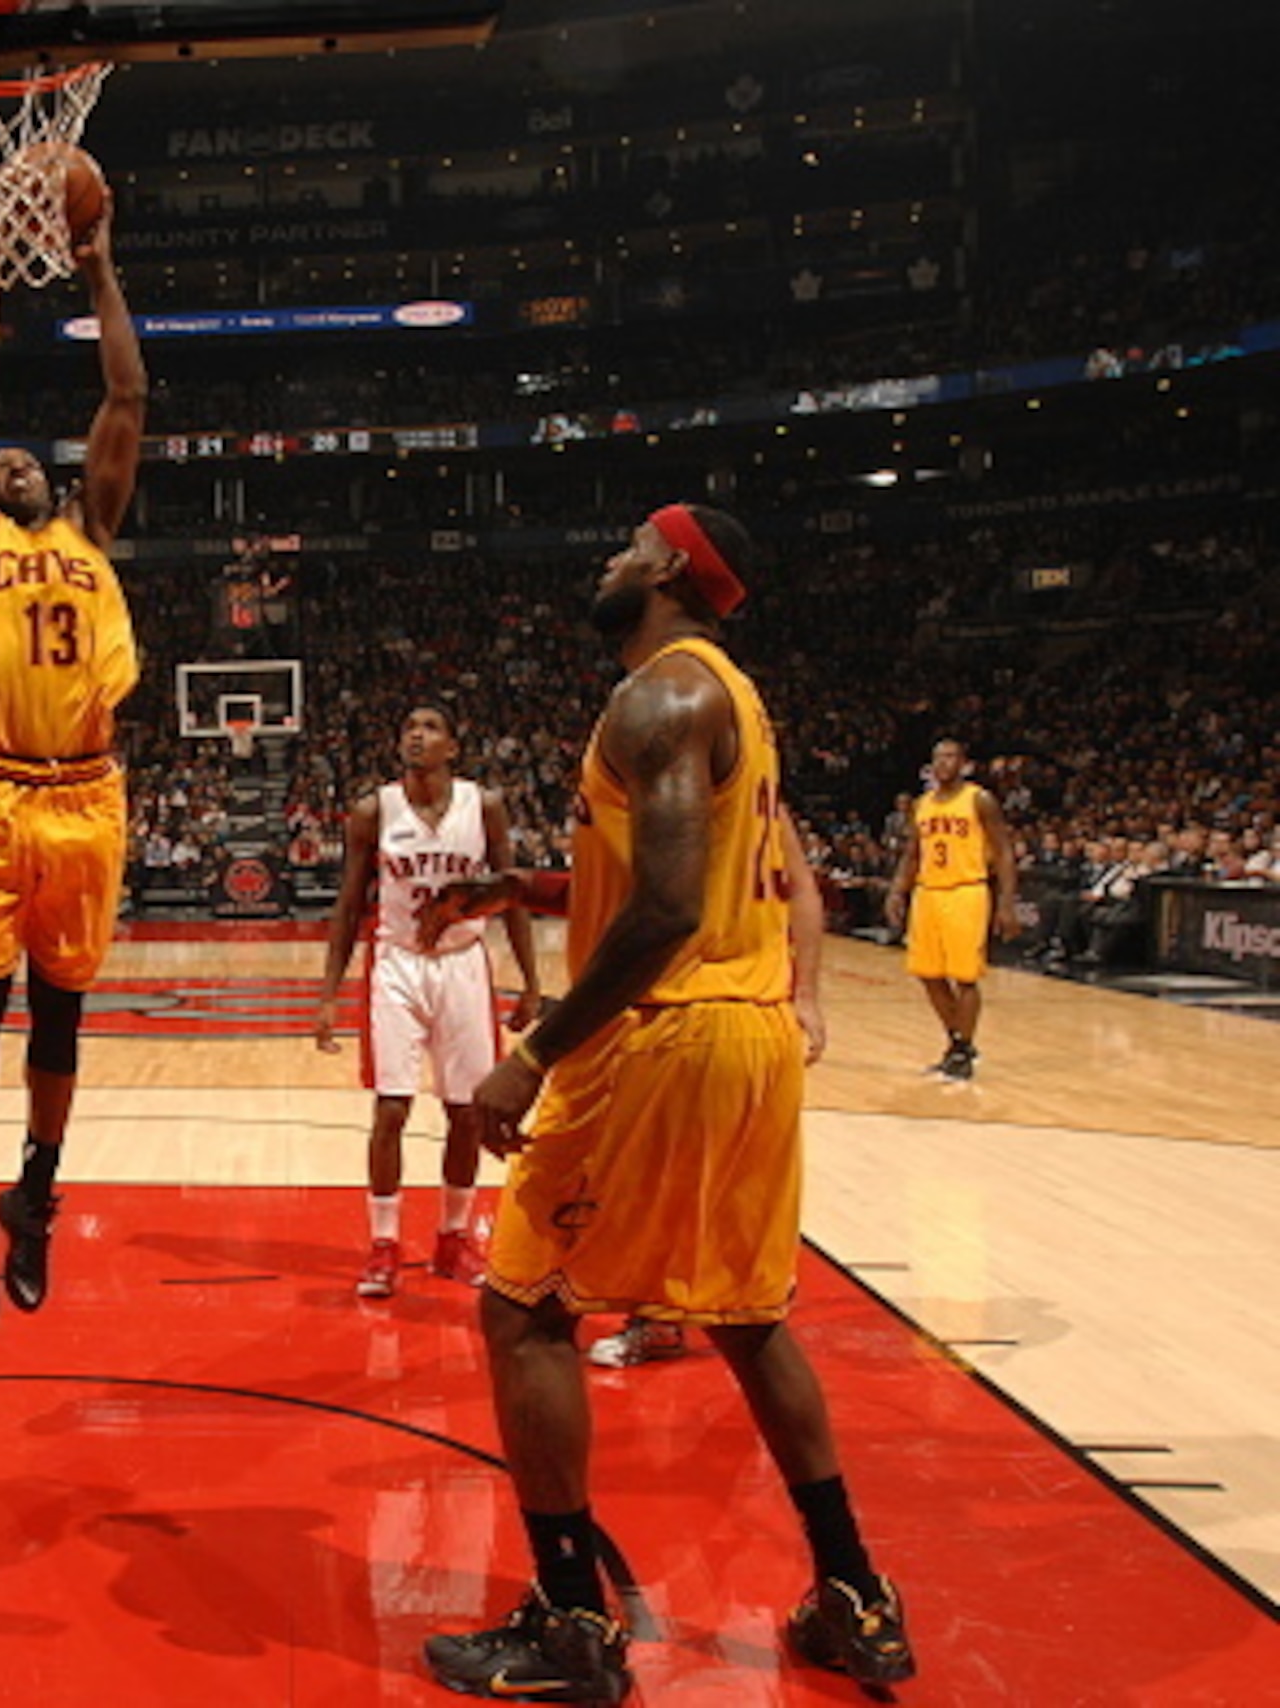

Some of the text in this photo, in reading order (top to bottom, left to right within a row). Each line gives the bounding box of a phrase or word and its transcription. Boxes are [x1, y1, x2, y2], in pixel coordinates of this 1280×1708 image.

[528, 104, 572, 134] Bell
[167, 127, 242, 158] FAN
[278, 120, 374, 152] DECK
[250, 220, 387, 244] PARTNER
[25, 601, 78, 666] 13
[933, 841, 947, 869] 3
